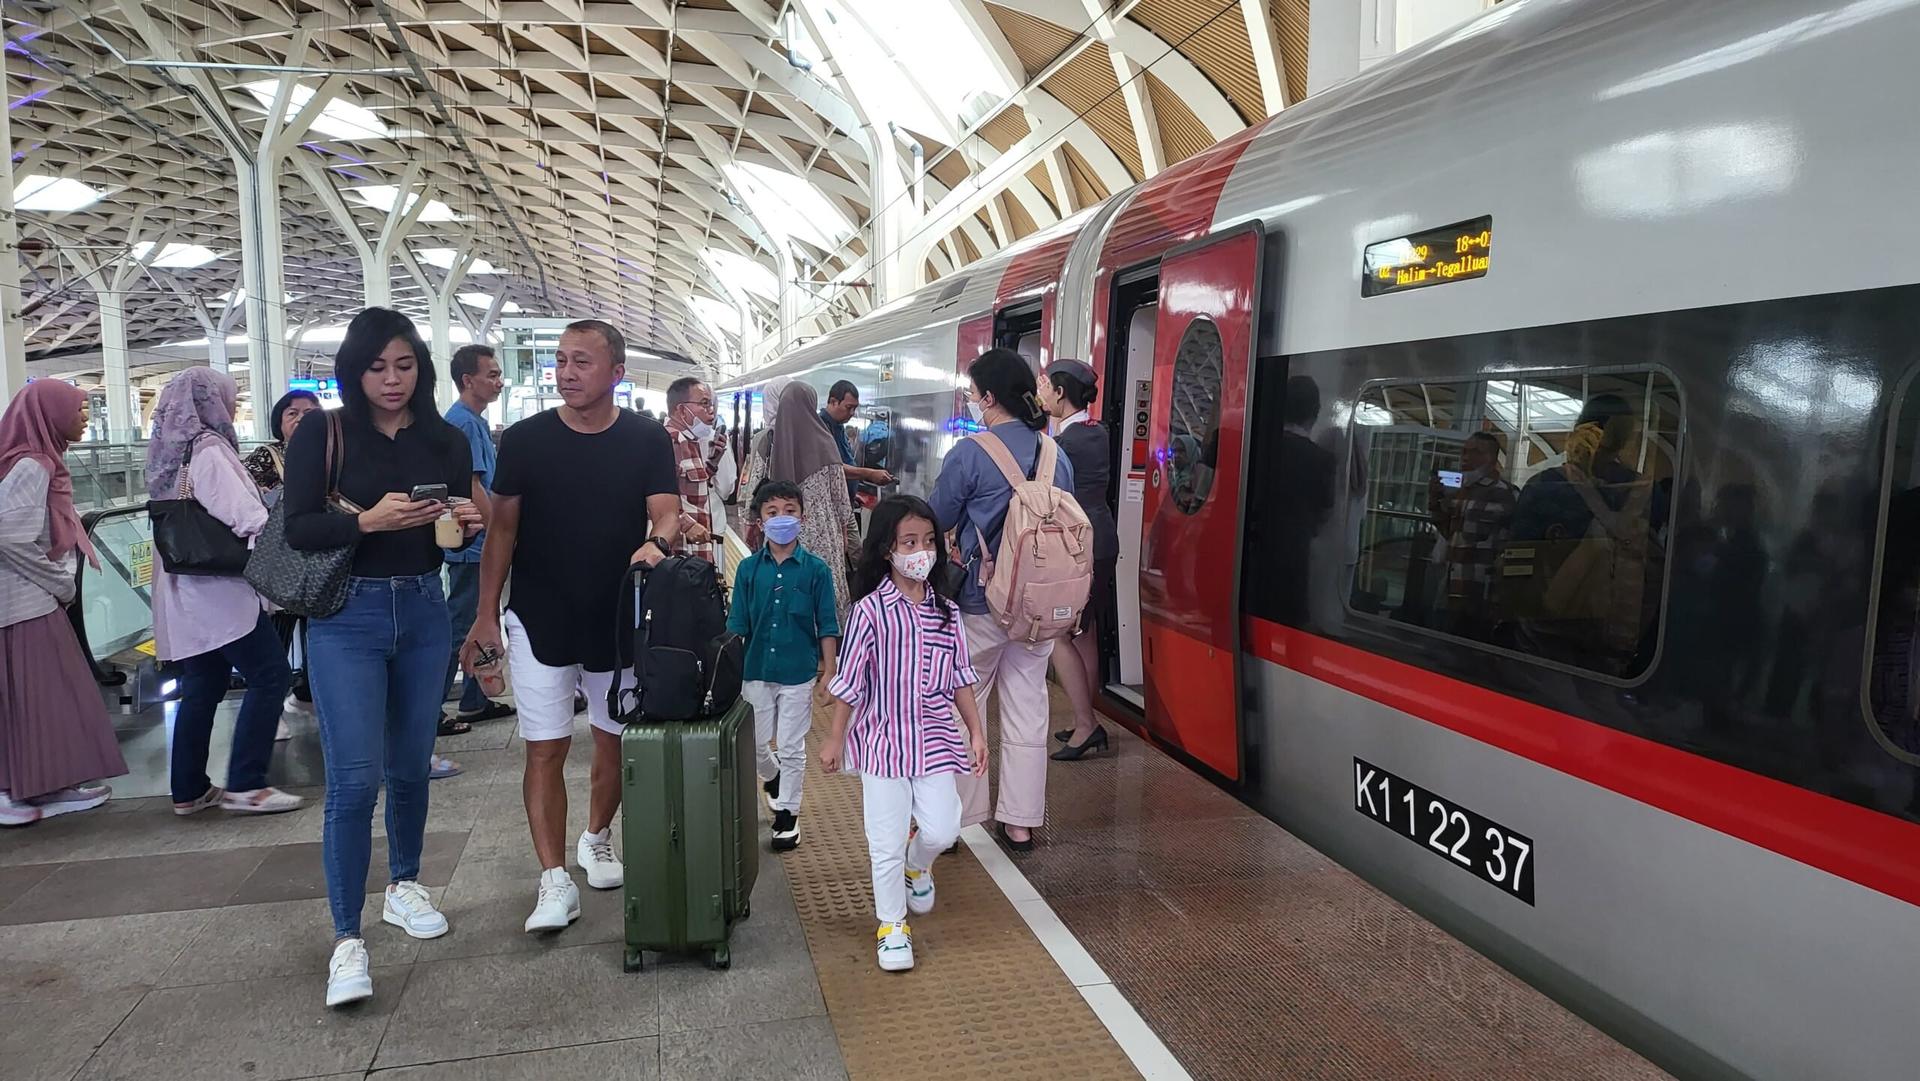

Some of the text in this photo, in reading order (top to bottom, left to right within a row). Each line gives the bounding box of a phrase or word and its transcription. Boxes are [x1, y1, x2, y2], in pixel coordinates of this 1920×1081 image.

[1456, 236, 1470, 254] 18
[1397, 265, 1425, 285] Halim
[1428, 801, 1471, 866] 22
[1485, 827, 1530, 891] 37
